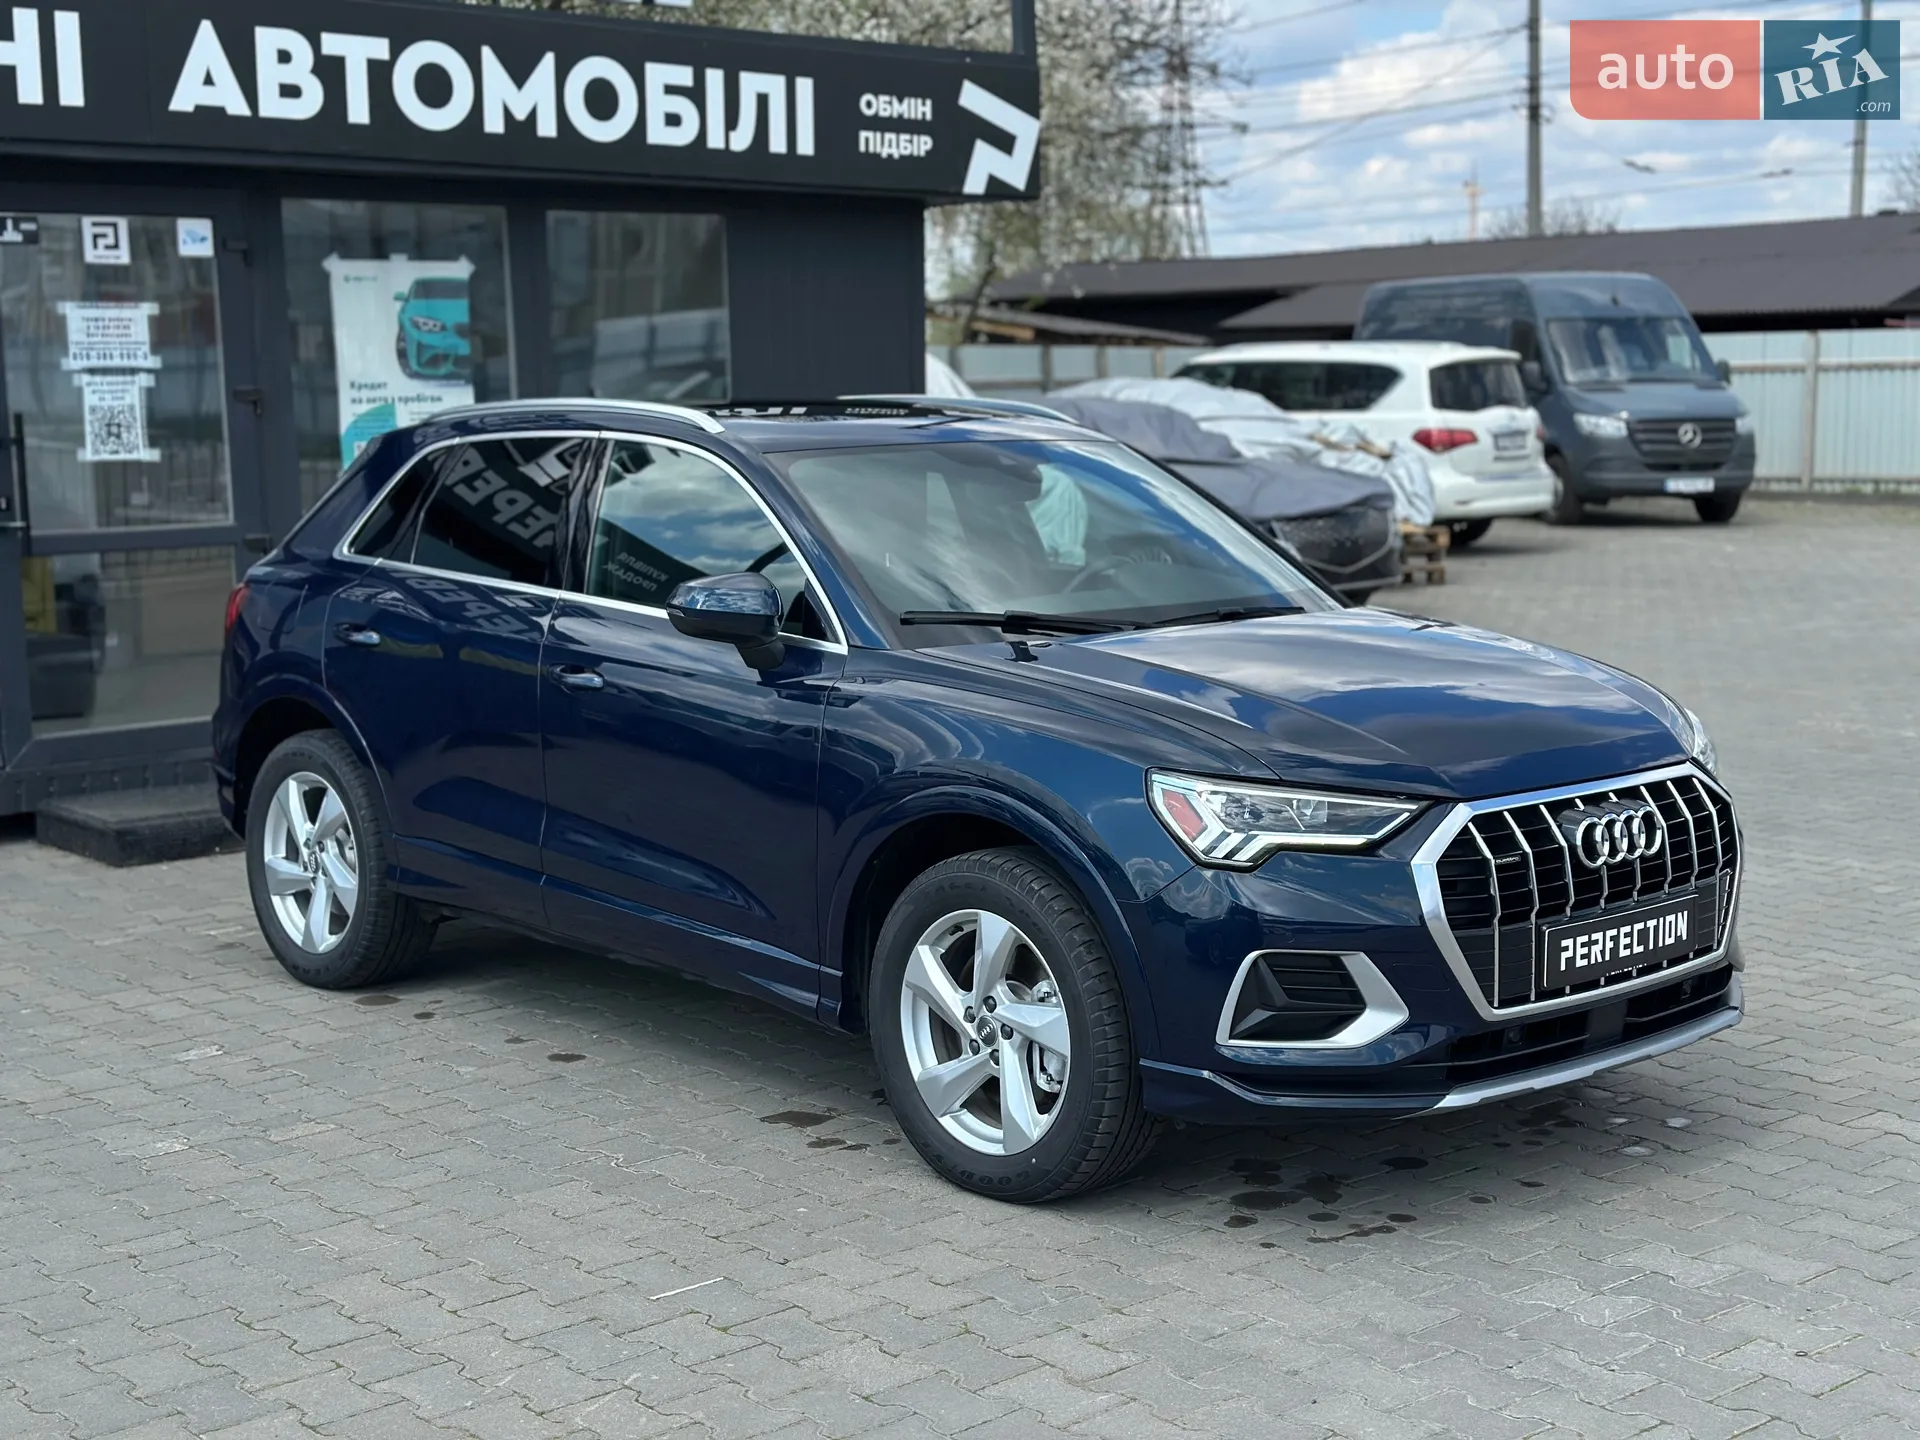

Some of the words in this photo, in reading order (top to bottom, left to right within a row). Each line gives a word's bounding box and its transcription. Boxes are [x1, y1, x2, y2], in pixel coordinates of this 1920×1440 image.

[168, 19, 815, 156] АВТОМОБІЛІ
[859, 93, 932, 121] ОБМІН
[858, 130, 933, 158] ПІДБІР
[1560, 910, 1688, 972] PERFECTION
